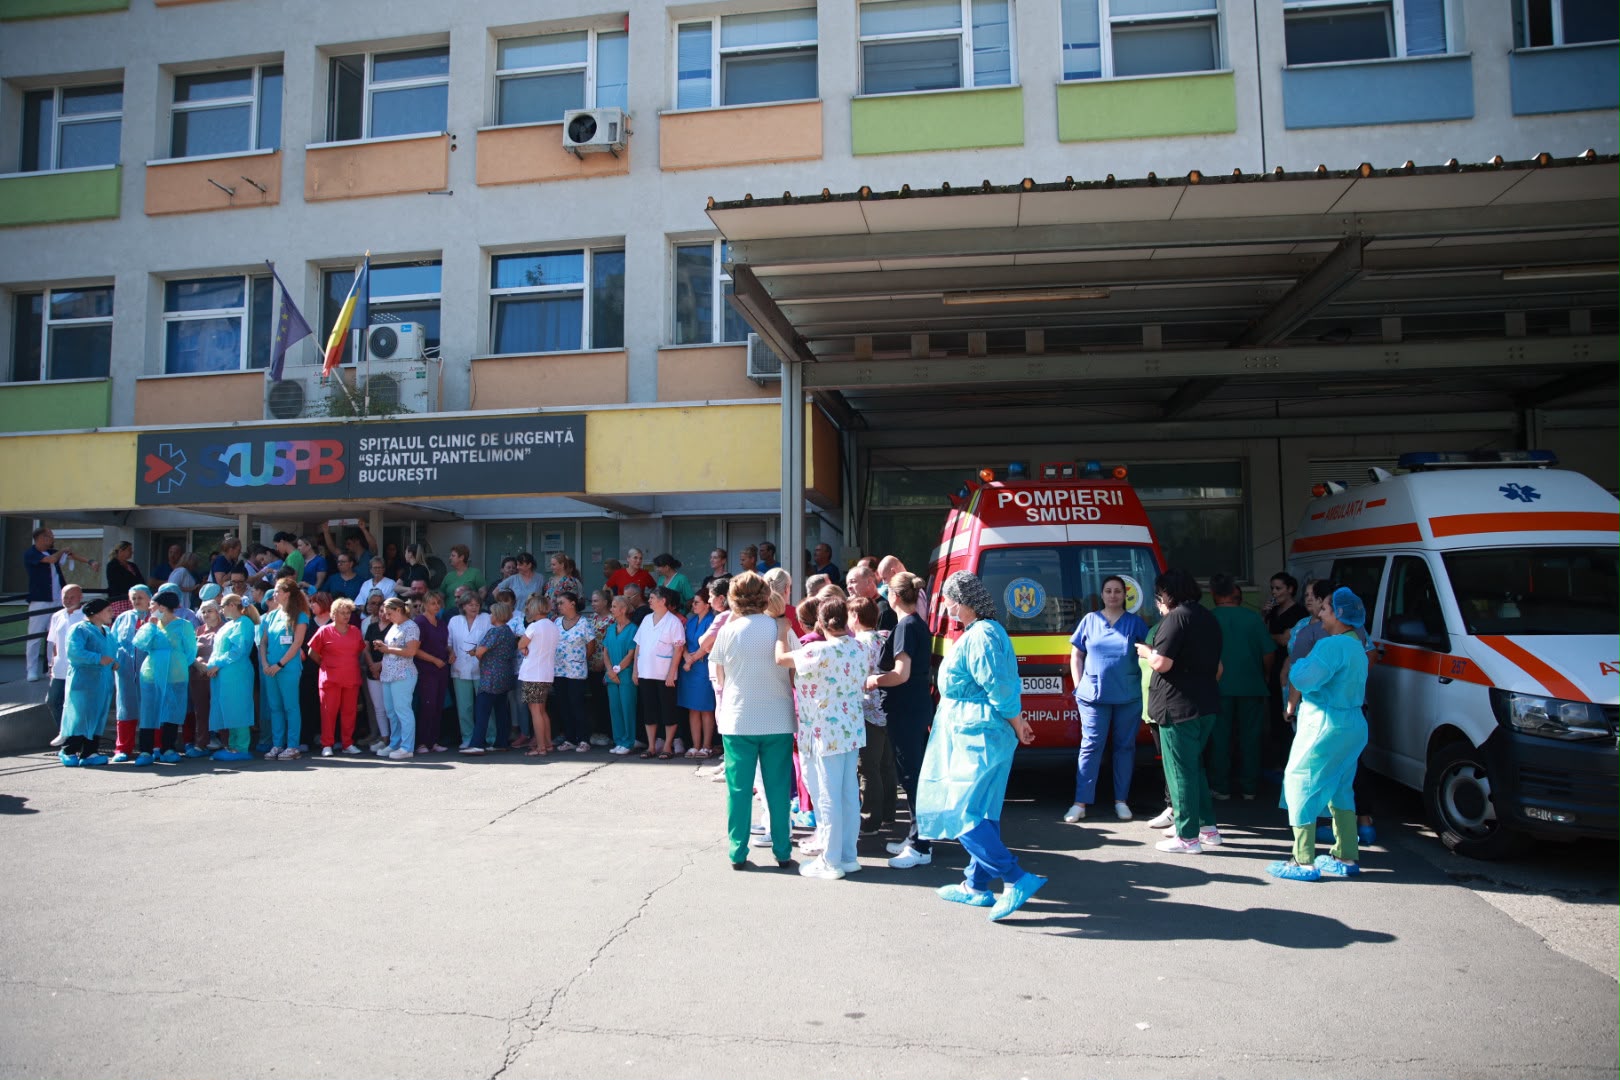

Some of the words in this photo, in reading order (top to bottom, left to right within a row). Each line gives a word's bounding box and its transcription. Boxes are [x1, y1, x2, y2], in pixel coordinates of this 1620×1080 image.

[359, 436, 424, 451] SPITALUL
[428, 434, 476, 449] CLINIC
[480, 432, 499, 446] DE
[504, 426, 575, 448] URGENȚĂ
[358, 467, 438, 485] BUCUREȘTI
[997, 489, 1124, 508] POMPIERII
[1026, 506, 1101, 522] SMURD
[1022, 677, 1060, 690] 50084
[1020, 710, 1059, 721] CHIPAJ
[1063, 710, 1079, 720] PR
